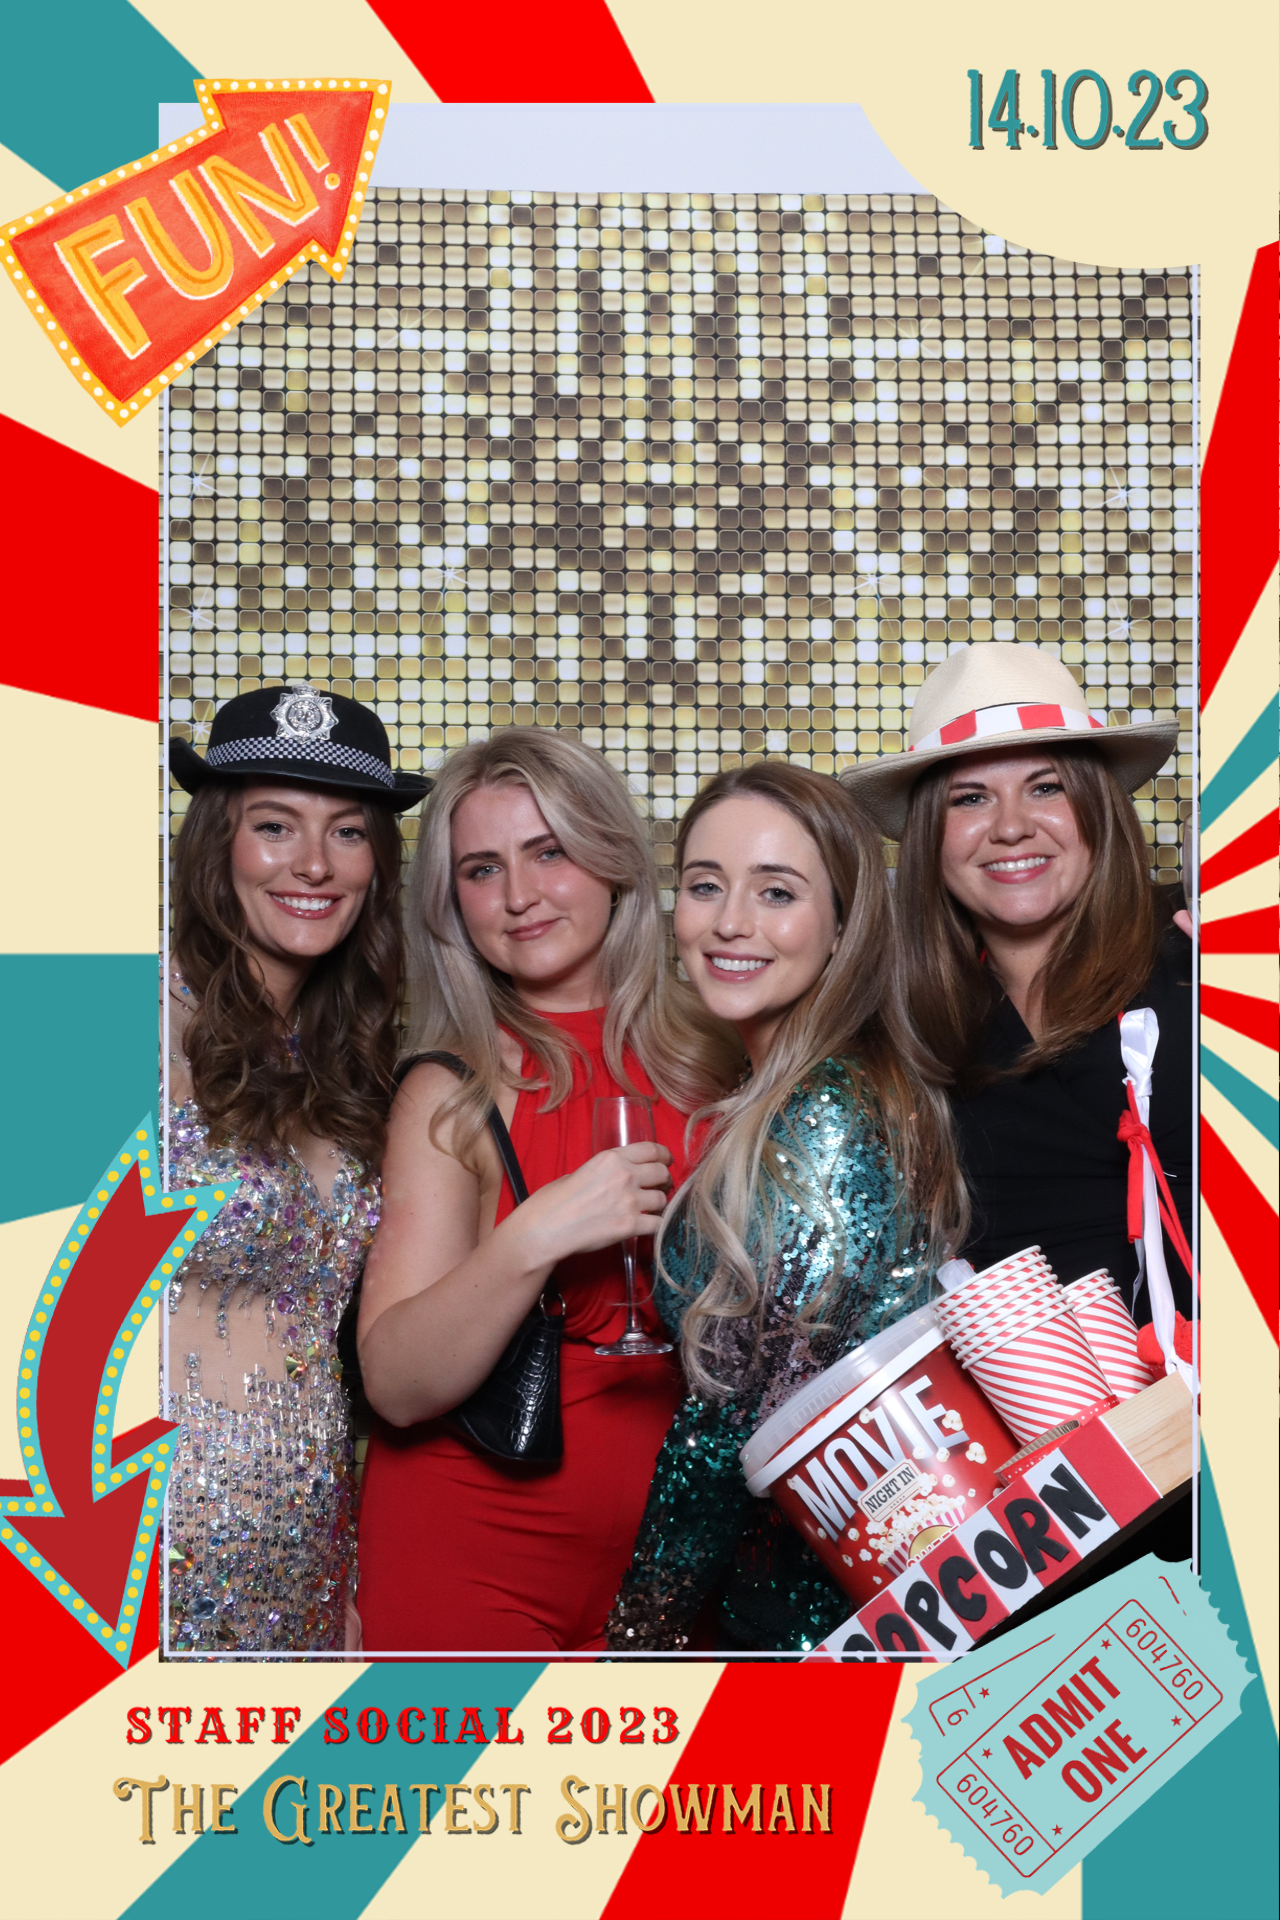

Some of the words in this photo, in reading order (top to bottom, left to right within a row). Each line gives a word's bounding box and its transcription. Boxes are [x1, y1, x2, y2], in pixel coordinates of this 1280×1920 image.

[793, 1374, 970, 1542] MOVIE
[864, 1475, 902, 1514] NIGHT
[896, 1466, 917, 1486] IN
